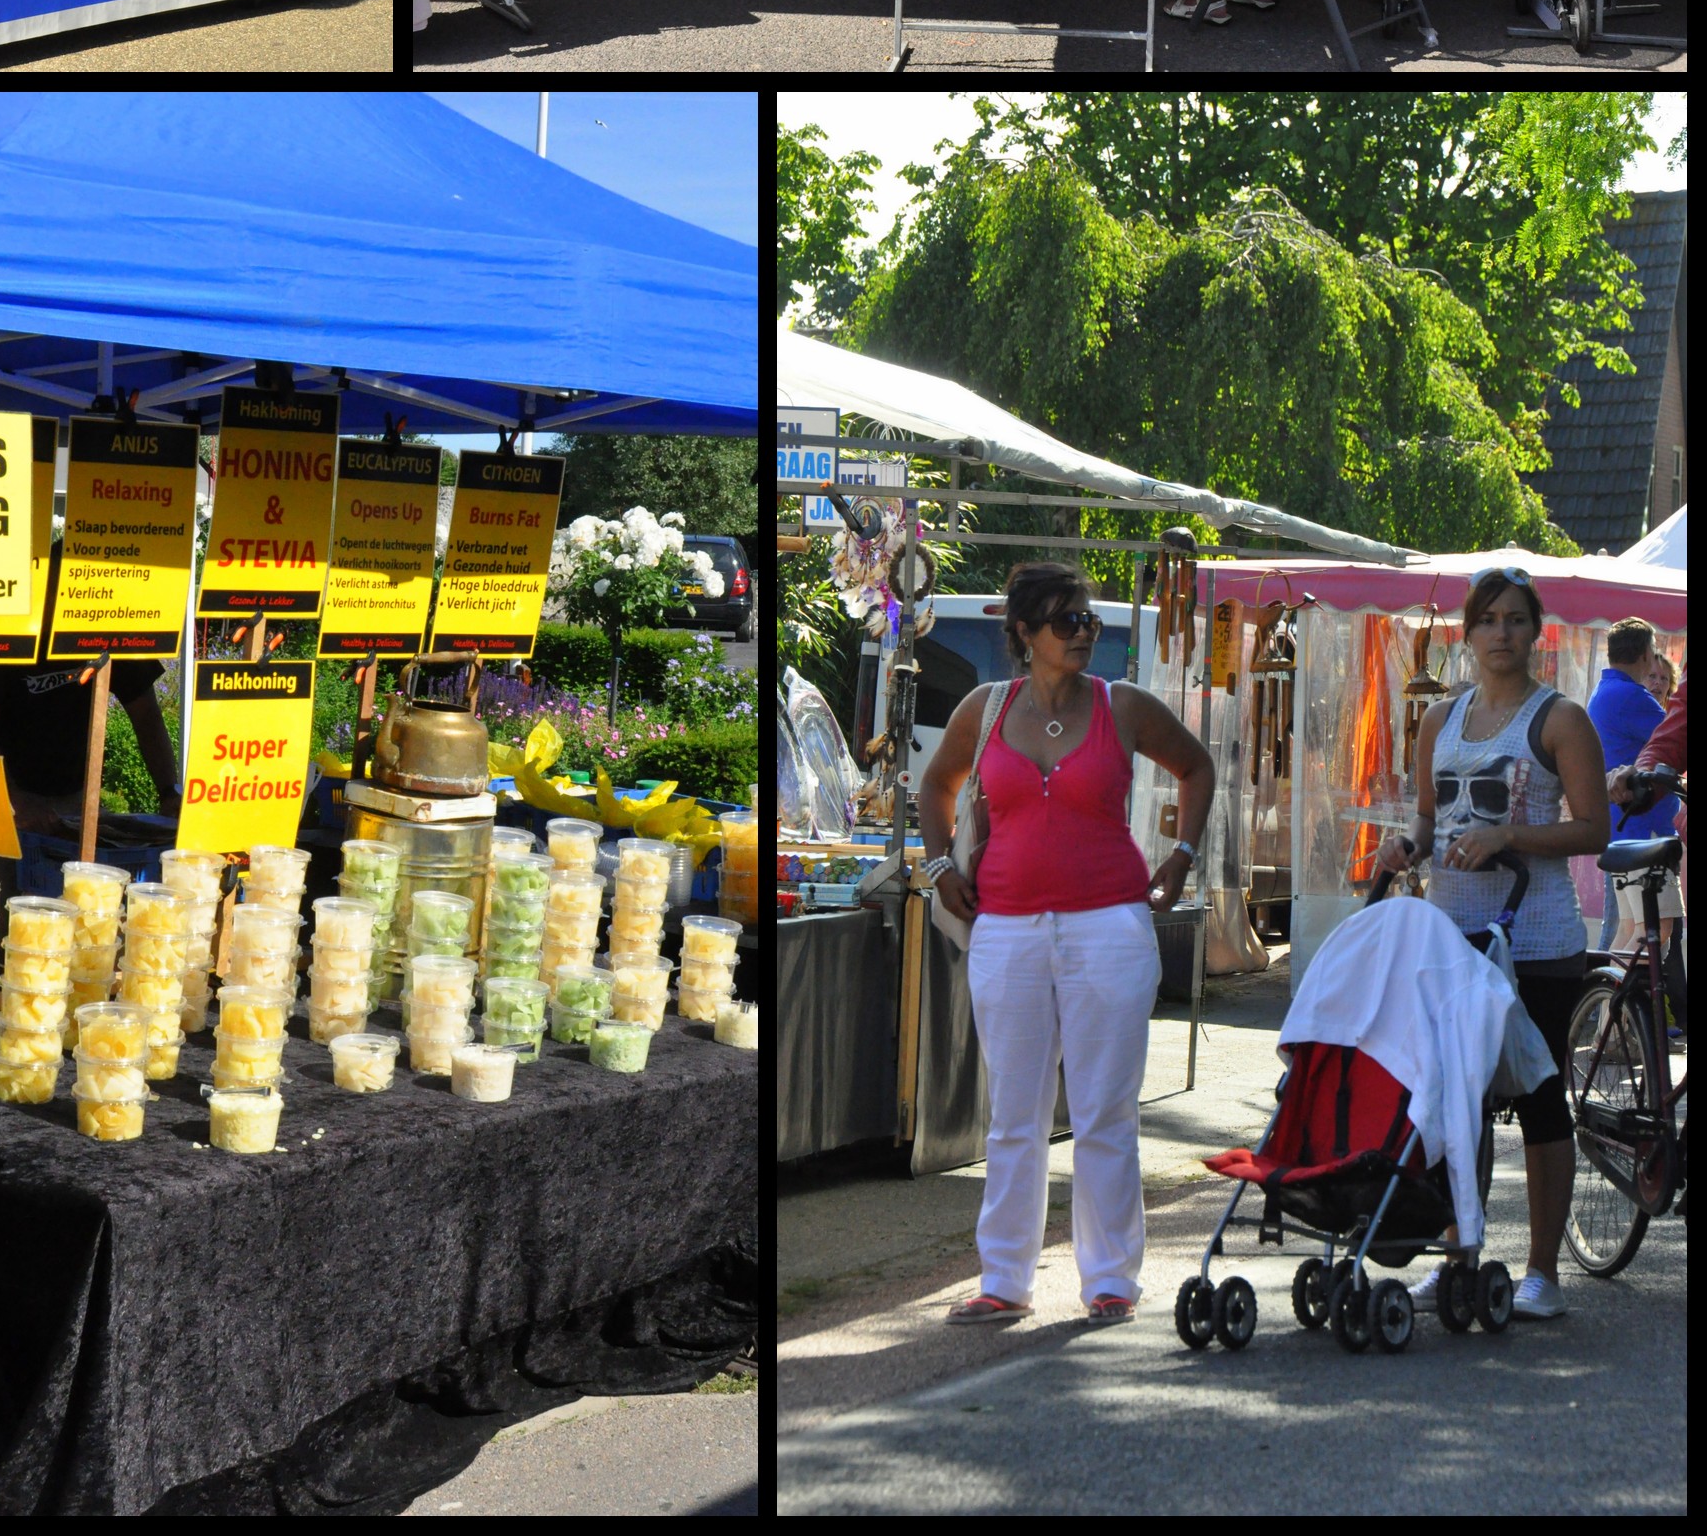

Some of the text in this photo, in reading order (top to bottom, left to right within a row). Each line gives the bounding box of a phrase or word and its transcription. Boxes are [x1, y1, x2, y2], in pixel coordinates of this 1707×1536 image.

[239, 400, 322, 426] Hakhoning
[111, 435, 159, 454] ANIJS
[220, 448, 332, 482] HONING
[348, 452, 432, 474] EUCALYPTUS
[482, 464, 541, 484] CITROEN
[92, 479, 172, 507] Relaxing
[350, 499, 423, 525] Opens Up
[469, 507, 541, 528] Burns Fat
[810, 498, 833, 520] JA
[75, 520, 184, 537] Slaap bevorderend
[73, 543, 140, 558] Voor goede
[217, 538, 316, 569] STEVIA
[340, 537, 432, 554] Opent de luchtwegen
[456, 540, 528, 556] Verbrand vet
[338, 557, 421, 571] Verlicht hooikoorts
[453, 559, 530, 574] Gezonde huid
[69, 565, 150, 581] spijsvertering
[335, 577, 398, 589] Verlicht astma
[450, 578, 539, 594] Hoge bloeddruk
[68, 587, 113, 600] Verlicht
[228, 596, 295, 606] Gezond Lekker
[332, 597, 416, 610] Verlicht bronchitus
[447, 597, 516, 613] Verlicht jicht
[63, 608, 161, 621] maagproblemen
[212, 672, 297, 693] Hakhoning
[213, 734, 287, 766] Super
[187, 775, 302, 805] Delicious
